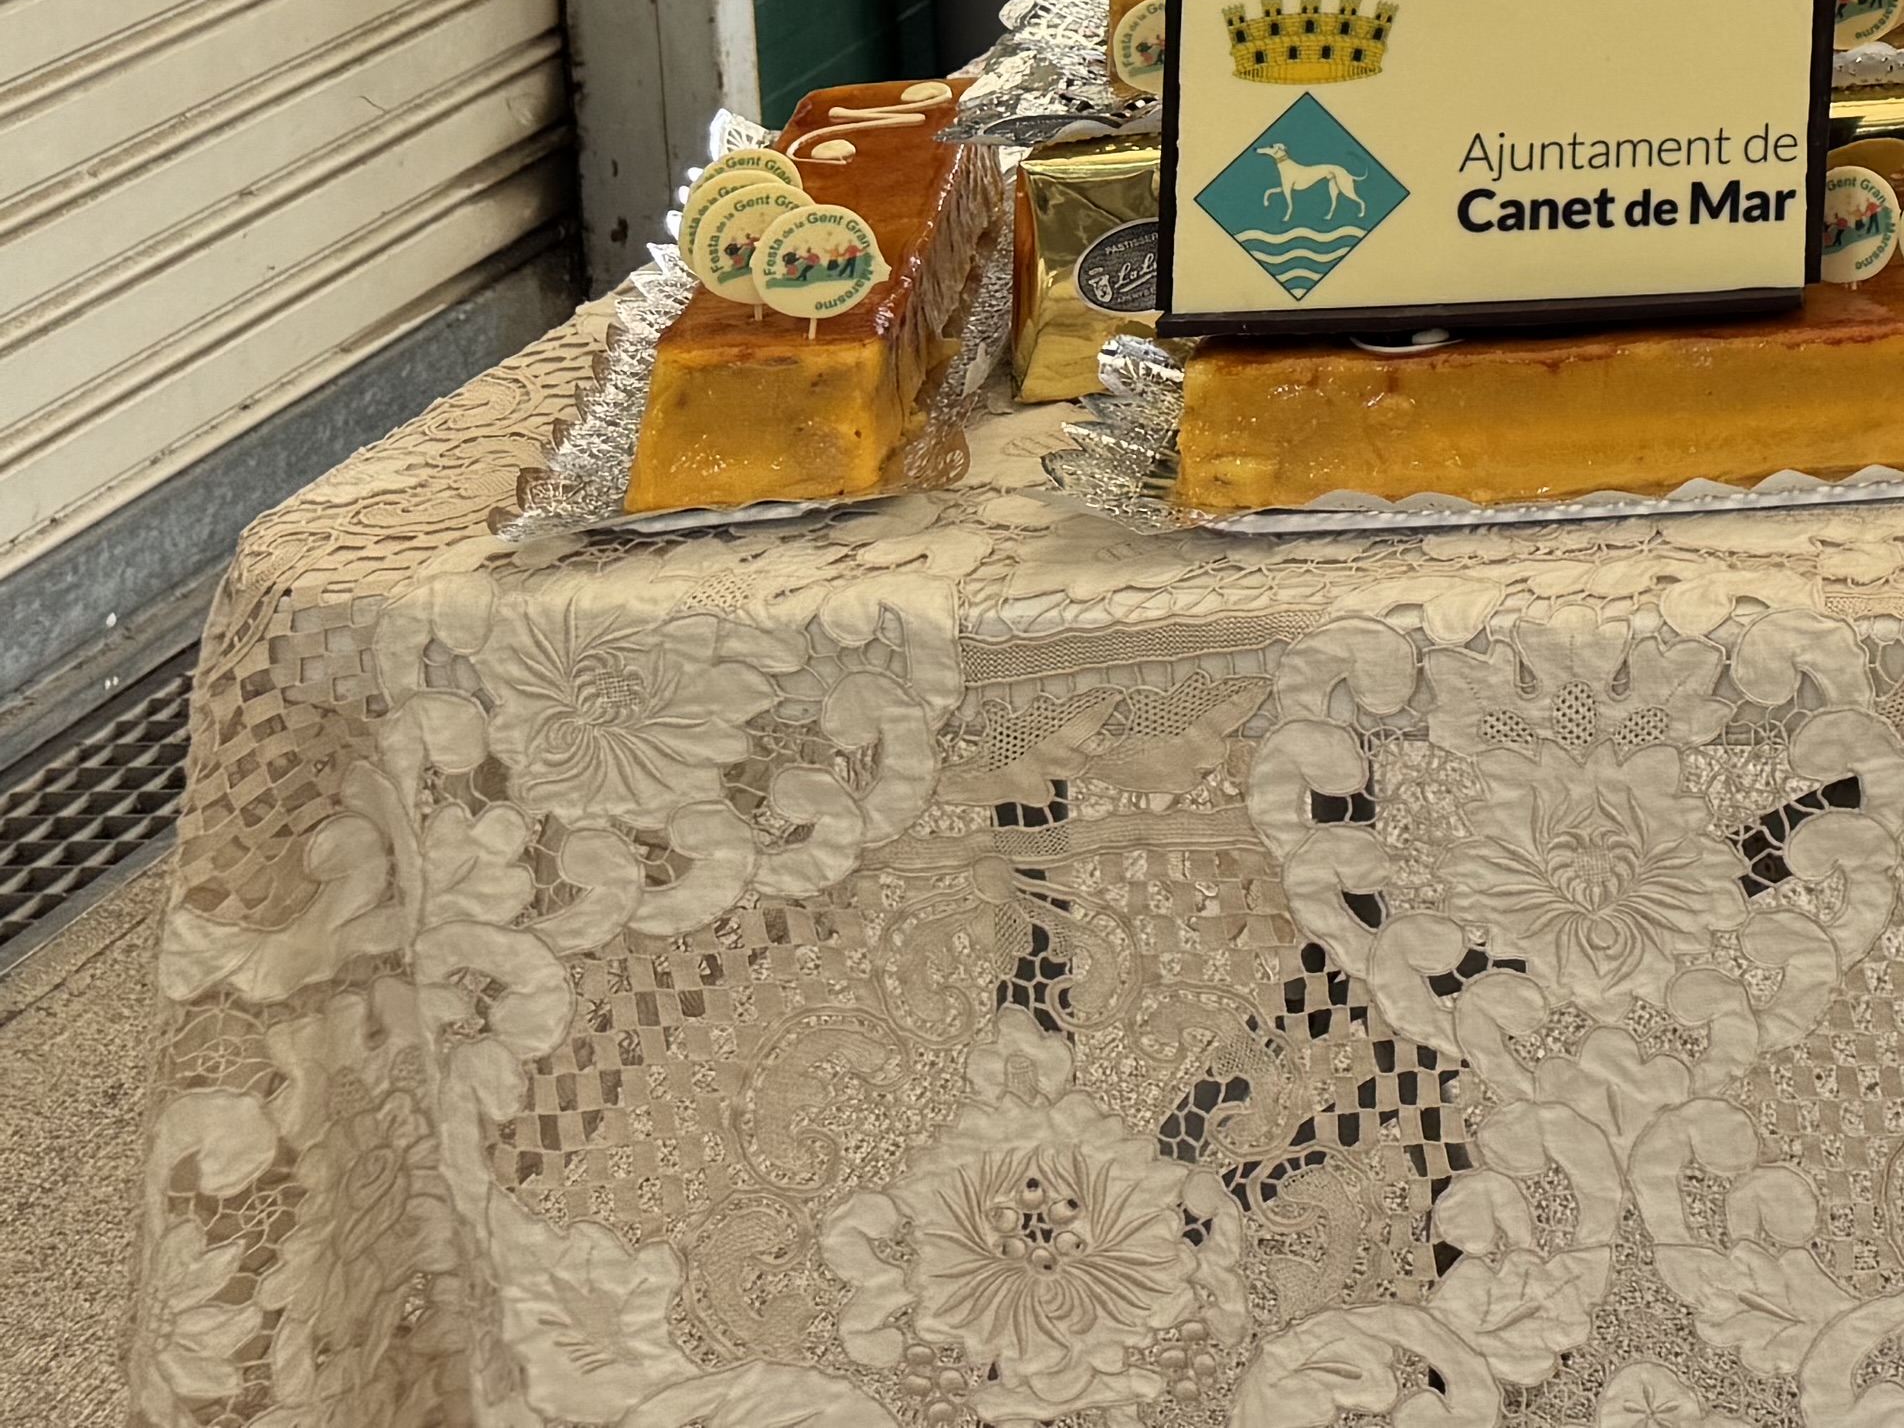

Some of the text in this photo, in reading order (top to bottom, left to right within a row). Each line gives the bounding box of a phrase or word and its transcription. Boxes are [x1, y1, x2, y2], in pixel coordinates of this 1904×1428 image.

[1458, 122, 1799, 182] Ajuntament de
[805, 212, 844, 226] Gent
[1457, 179, 1797, 234] Canet de Mar
[846, 219, 871, 249] Gran
[763, 238, 783, 277] Festa
[814, 270, 874, 311] Maresme
